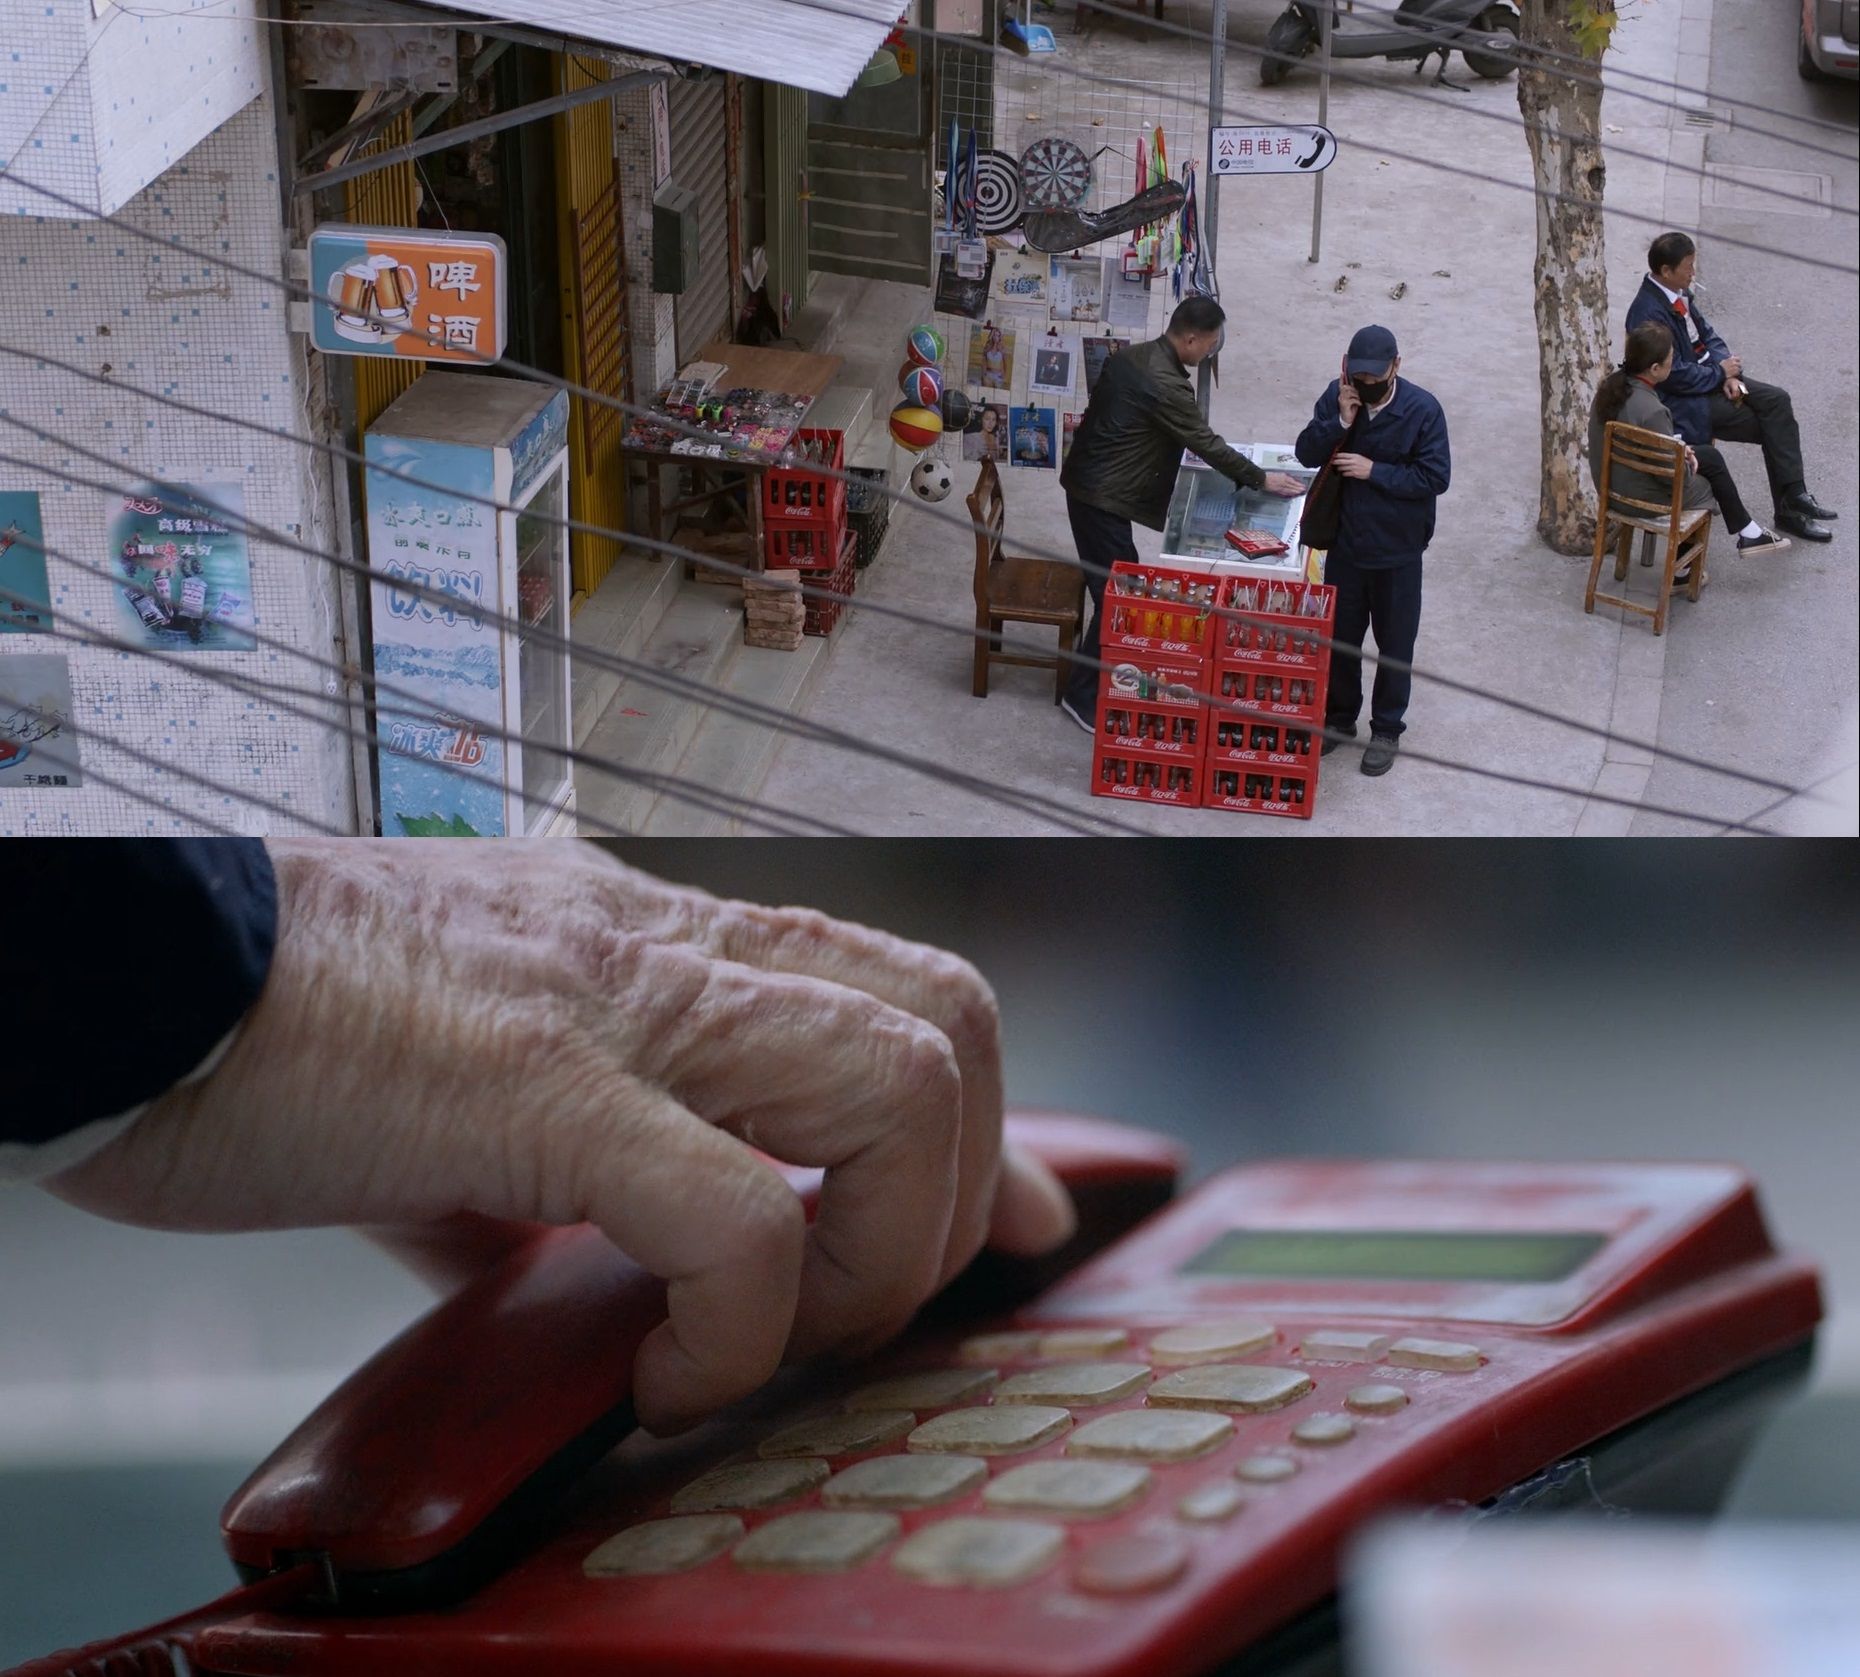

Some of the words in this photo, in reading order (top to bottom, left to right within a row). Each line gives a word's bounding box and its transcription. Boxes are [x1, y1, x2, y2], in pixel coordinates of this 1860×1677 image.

[1219, 138, 1292, 156] 公用电话
[429, 261, 481, 350] 啤酒
[387, 562, 482, 628] 饮料
